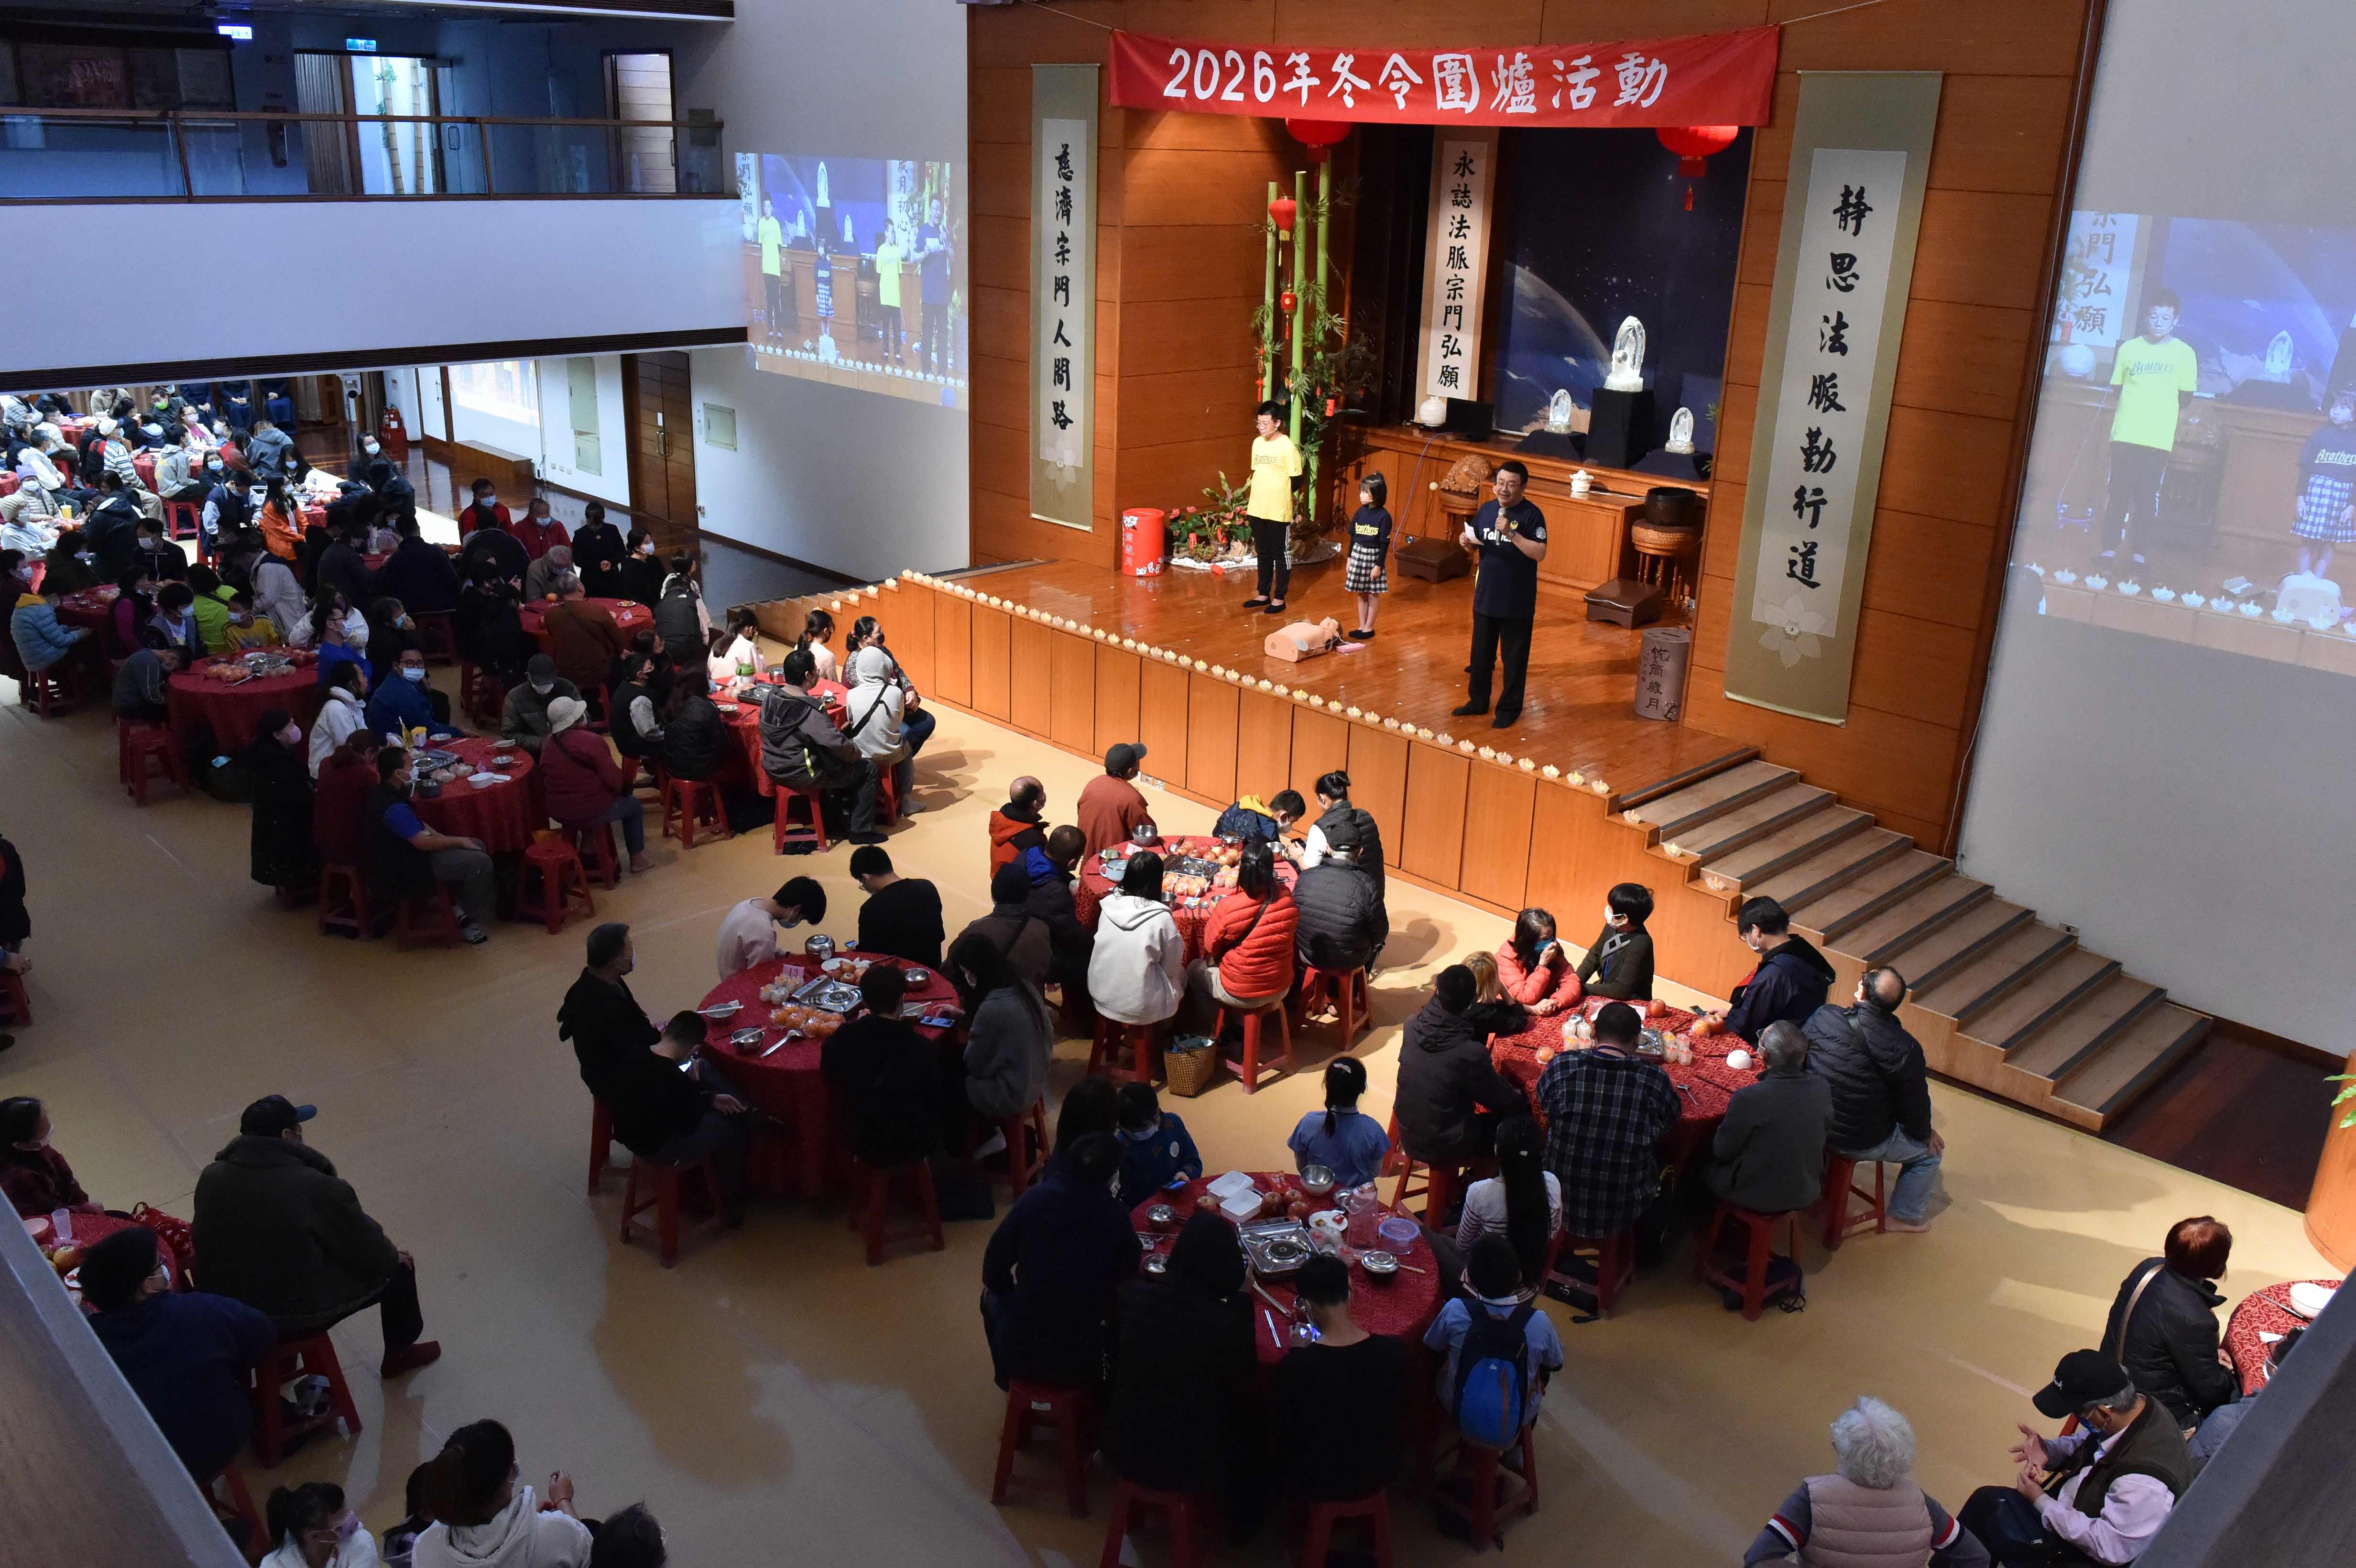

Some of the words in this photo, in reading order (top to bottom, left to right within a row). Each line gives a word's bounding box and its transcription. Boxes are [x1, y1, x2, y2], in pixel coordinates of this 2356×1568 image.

[1163, 47, 1668, 113] 2026年冬令圍爐活動
[1051, 143, 1074, 430] 慈濟宗門人間路
[1437, 150, 1475, 390] 永誌法脈宗門弘願
[789, 968, 799, 977] 13
